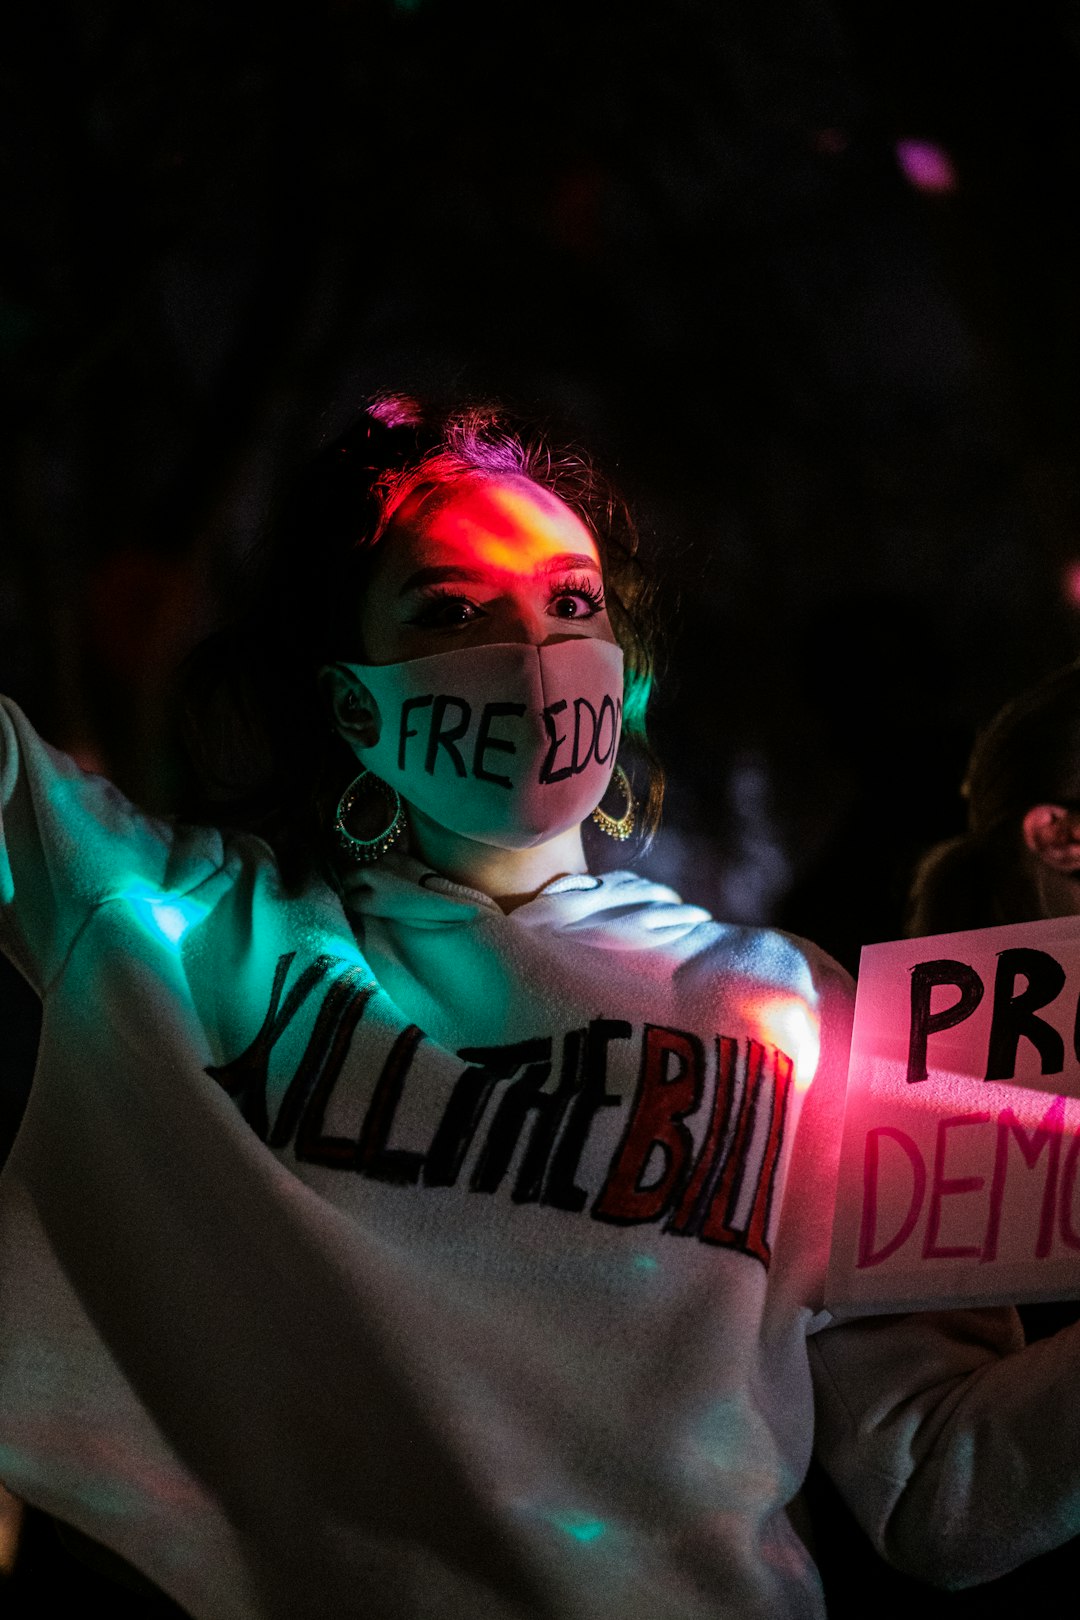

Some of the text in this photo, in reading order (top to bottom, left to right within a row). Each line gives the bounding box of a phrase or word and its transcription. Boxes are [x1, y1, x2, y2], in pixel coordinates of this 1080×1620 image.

[907, 948, 1080, 1084] PR
[423, 1017, 632, 1213] THE
[591, 1022, 793, 1274] BILL
